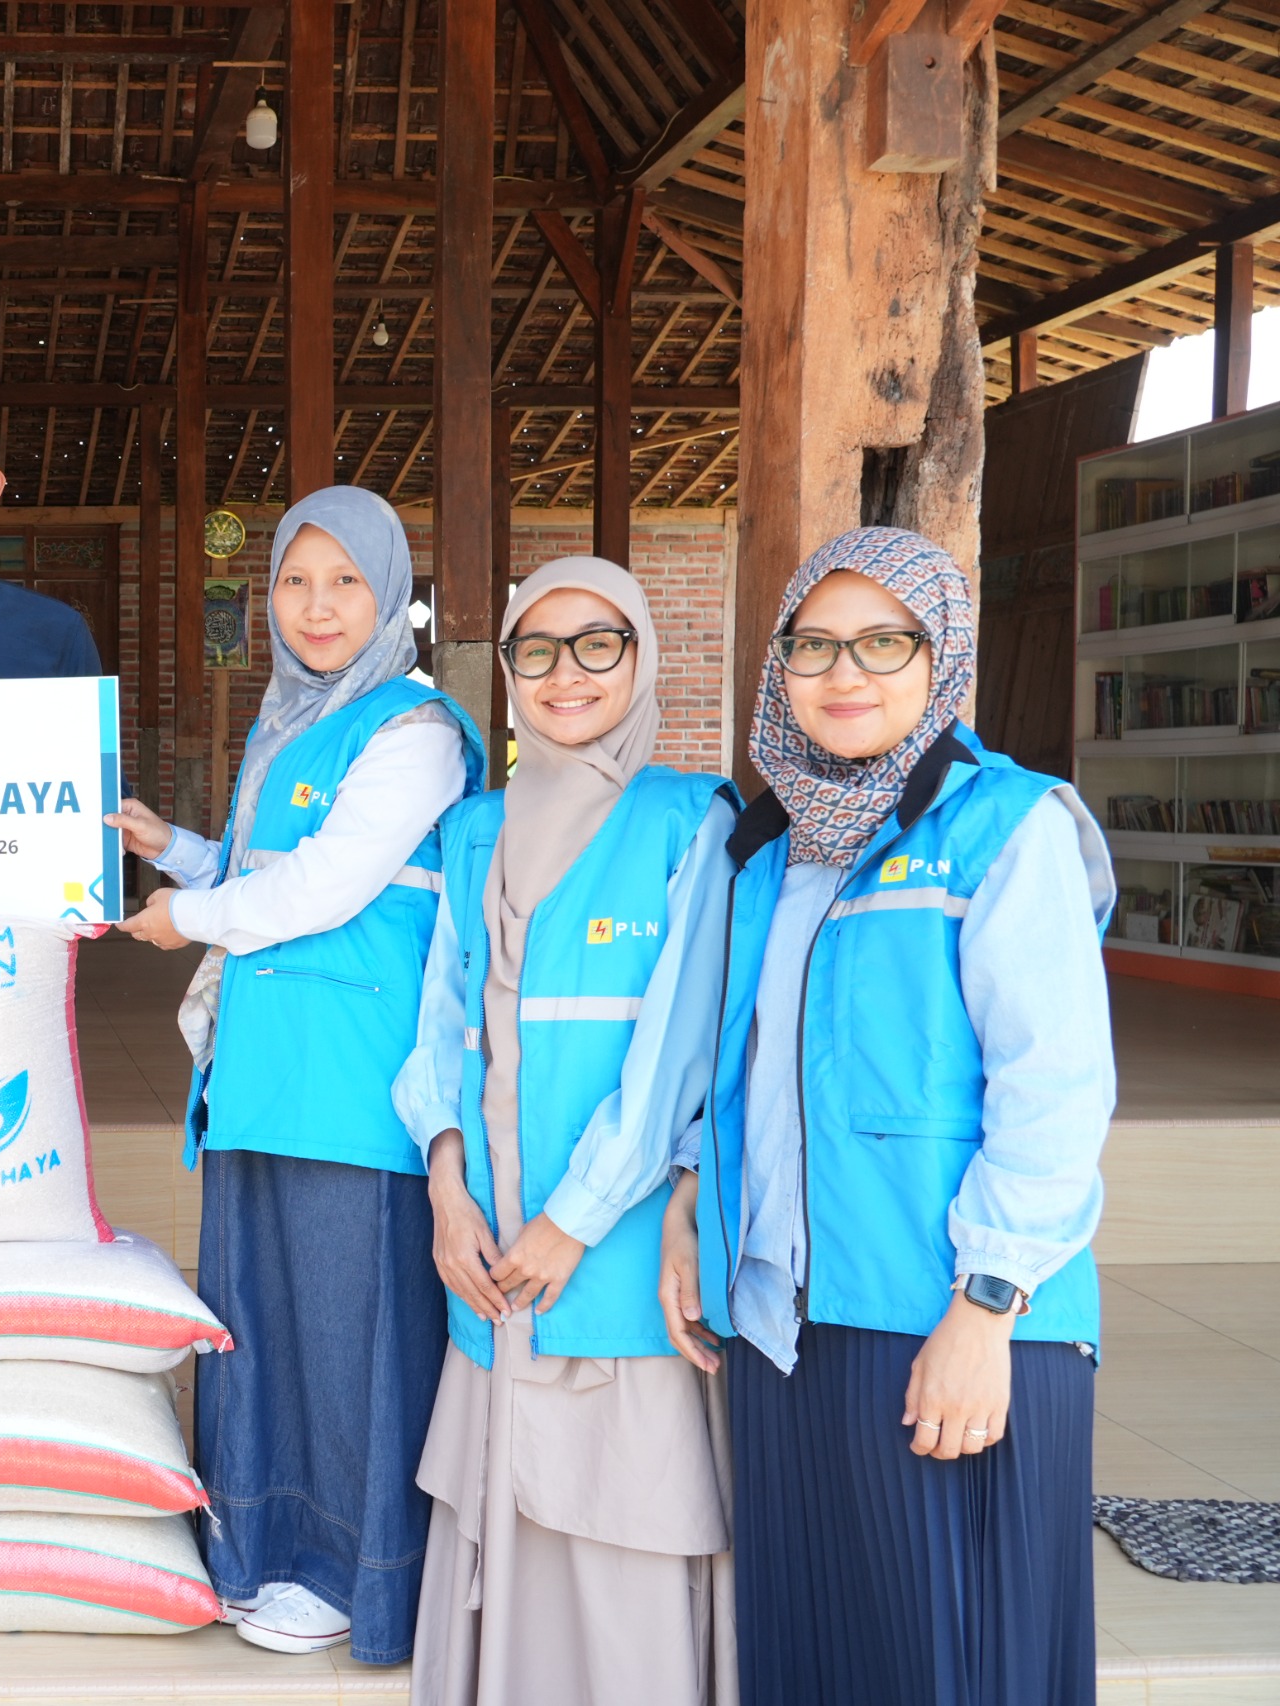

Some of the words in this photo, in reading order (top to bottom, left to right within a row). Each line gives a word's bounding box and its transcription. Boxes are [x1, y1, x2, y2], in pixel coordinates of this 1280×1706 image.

[311, 791, 336, 807] PL
[909, 859, 951, 877] PLN
[615, 921, 659, 937] PLN
